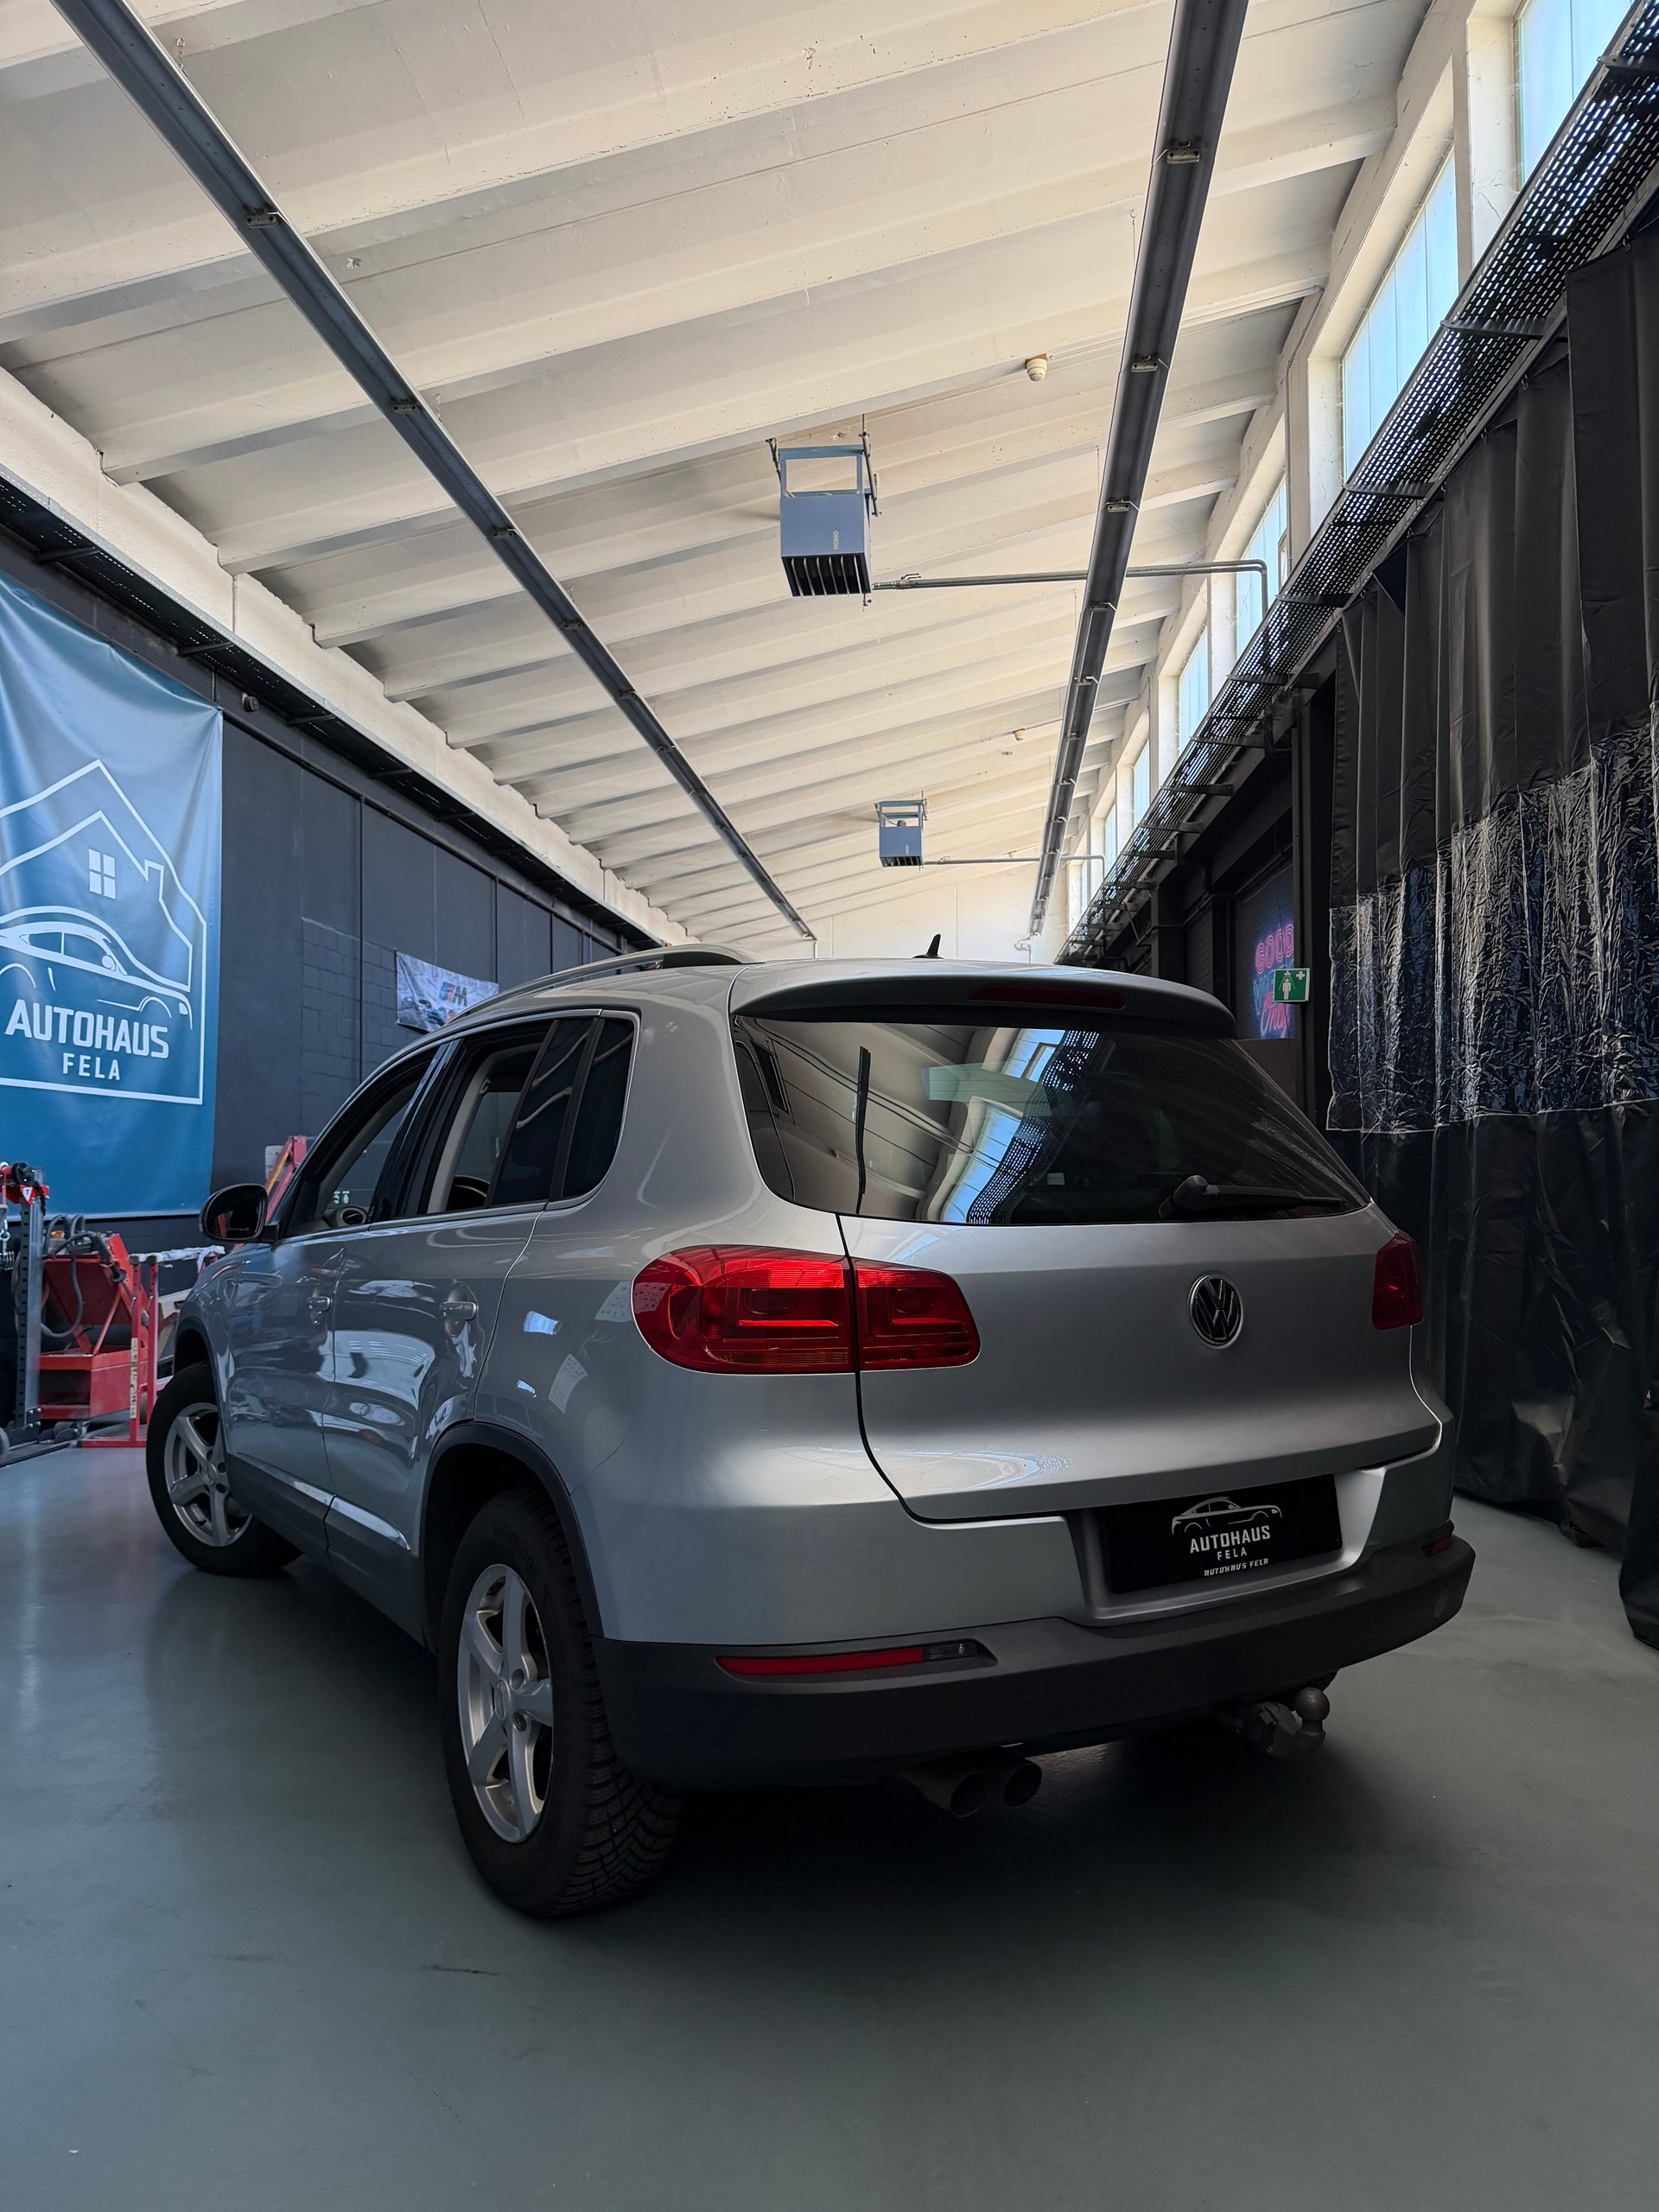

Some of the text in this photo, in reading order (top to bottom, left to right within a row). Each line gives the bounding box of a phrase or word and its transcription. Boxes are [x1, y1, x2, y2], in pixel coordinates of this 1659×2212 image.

[1255, 924, 1294, 975] GOOD
[4, 999, 169, 1058] AUTOHAUS
[62, 1052, 120, 1080] FELA
[1191, 1276, 1242, 1344] VW
[1190, 1525, 1270, 1554] AUTOHAUS
[1217, 1547, 1247, 1560] FELA
[1204, 1558, 1268, 1577] AUTOHAUS FELA
